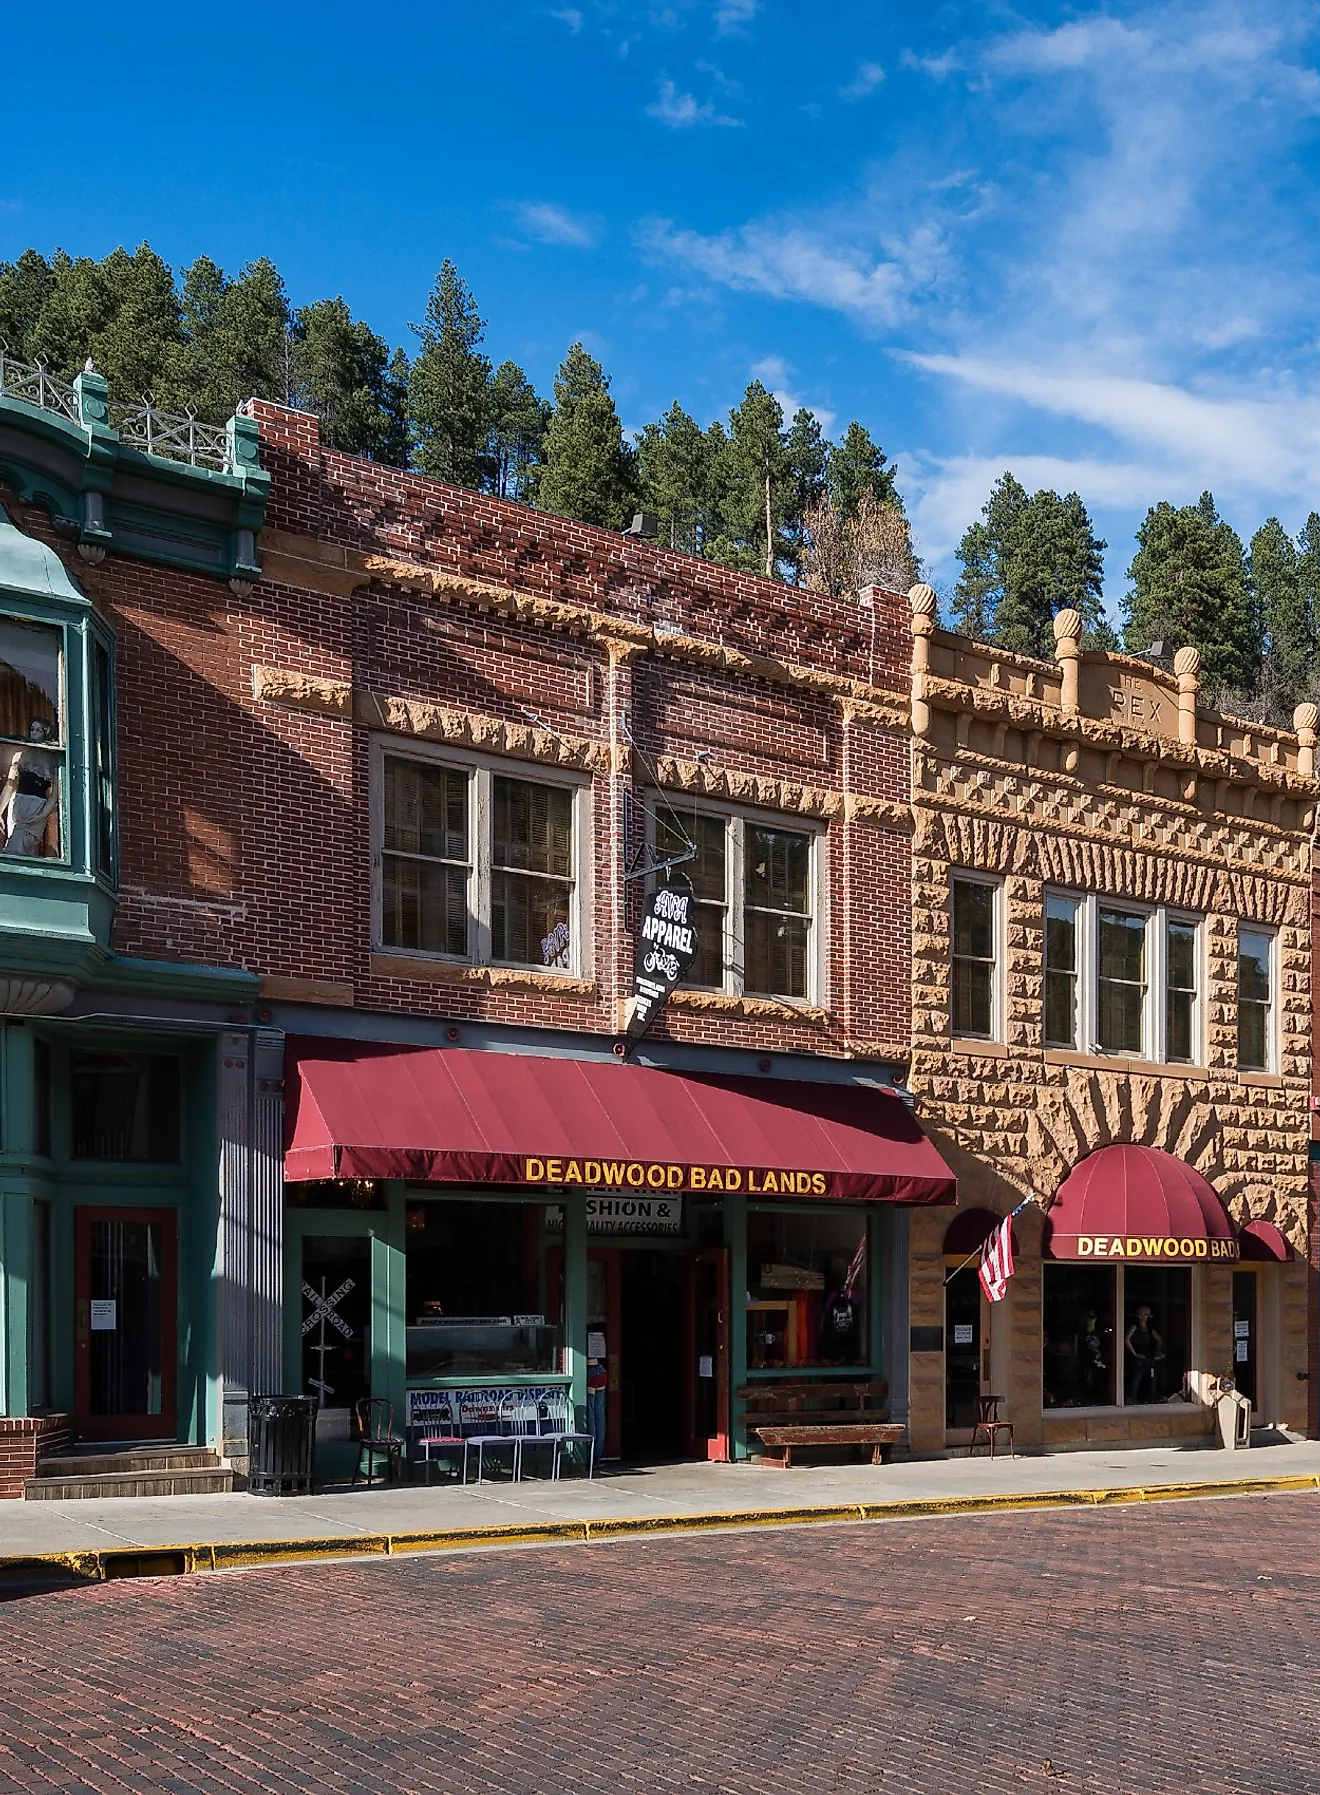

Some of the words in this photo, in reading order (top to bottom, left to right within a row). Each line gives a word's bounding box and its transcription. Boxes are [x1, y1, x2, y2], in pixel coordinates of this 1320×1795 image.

[642, 916, 693, 955] APPAREL
[525, 1158, 684, 1189] DEADWOOD
[690, 1167, 742, 1191] BAD
[748, 1170, 827, 1195] LANDS
[586, 1200, 651, 1217] SHION
[656, 1202, 671, 1218] &
[586, 1220, 616, 1233] ALITY
[1077, 1237, 1207, 1257] DEADWOOD
[410, 1391, 451, 1405] MODEL
